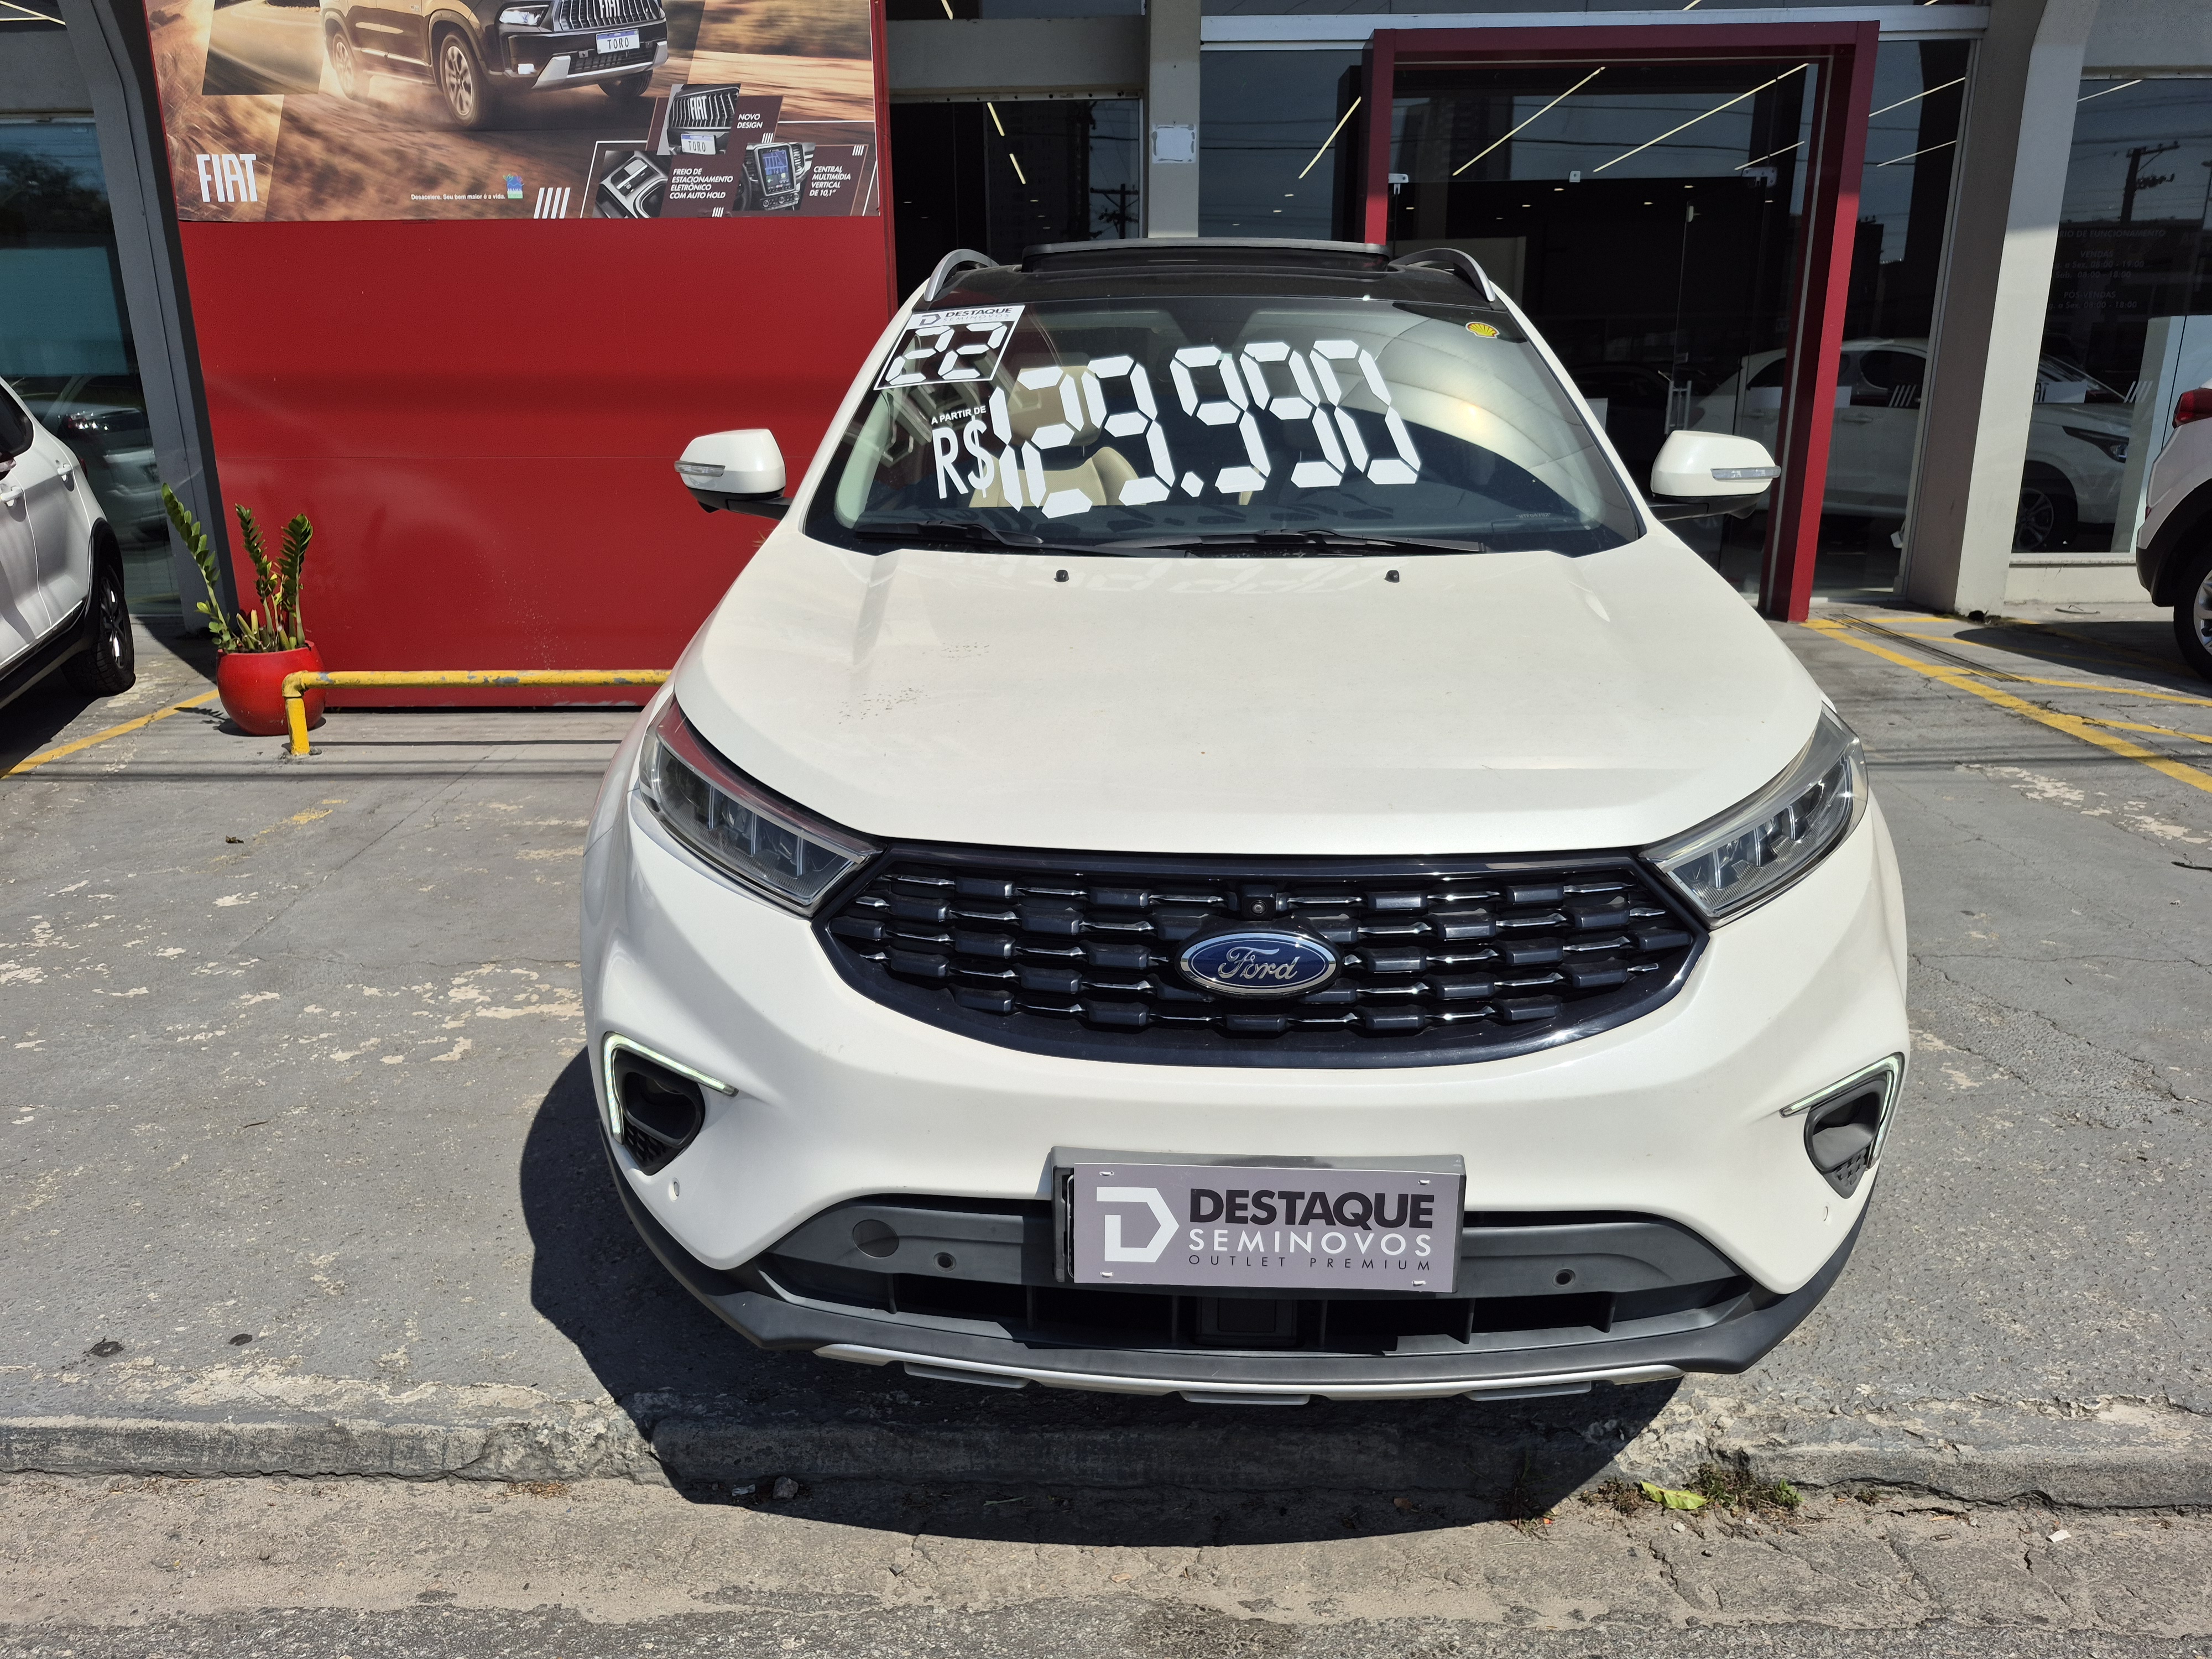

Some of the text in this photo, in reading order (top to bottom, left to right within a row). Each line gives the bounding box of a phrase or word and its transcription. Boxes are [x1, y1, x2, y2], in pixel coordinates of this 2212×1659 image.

[607, 37, 629, 50] TORO
[690, 96, 708, 121] FIAT
[688, 140, 706, 153] TORO
[196, 153, 258, 202] FIAT
[812, 173, 851, 181] MULTIMÍDIA
[670, 183, 712, 191] ELETRÔNICO
[2076, 229, 2088, 238] DE
[2089, 229, 2167, 238] FUNCIONAMENTO
[2080, 250, 2114, 258] VENDAS
[2090, 260, 2114, 269] 08:00
[2063, 290, 2116, 299] PÓS-VENDAS
[2084, 301, 2107, 309] 08:00
[943, 314, 1010, 322] SEMINOVOS
[945, 307, 1013, 318] DESTAQUE
[885, 322, 1008, 385] 22
[931, 405, 987, 425] A PARTIR DE
[1217, 946, 1300, 980] Ford
[1190, 1188, 1434, 1232] DESTAQUE
[1189, 1228, 1432, 1258] SEMINOVOS
[1188, 1255, 1431, 1271] OUTLET PREMIUM
